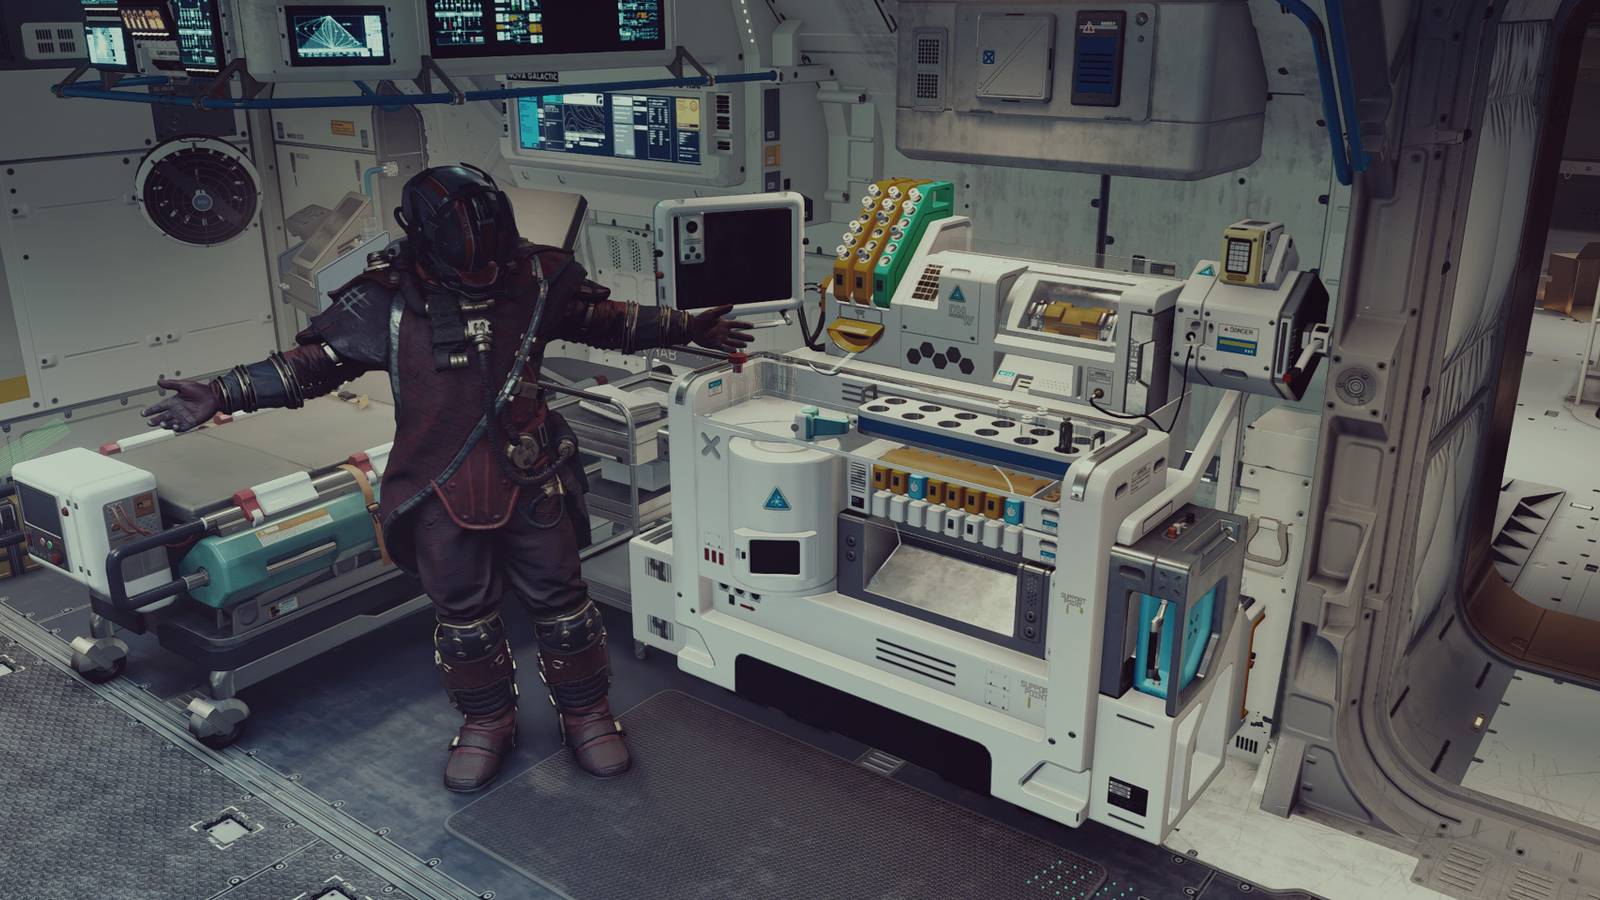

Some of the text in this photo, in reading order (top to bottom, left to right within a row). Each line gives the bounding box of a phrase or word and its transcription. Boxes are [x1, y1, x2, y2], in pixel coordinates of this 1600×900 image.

[528, 72, 558, 81] GALACTIC
[1229, 326, 1254, 336] DANGER
[1020, 680, 1048, 694] SUPPOR
